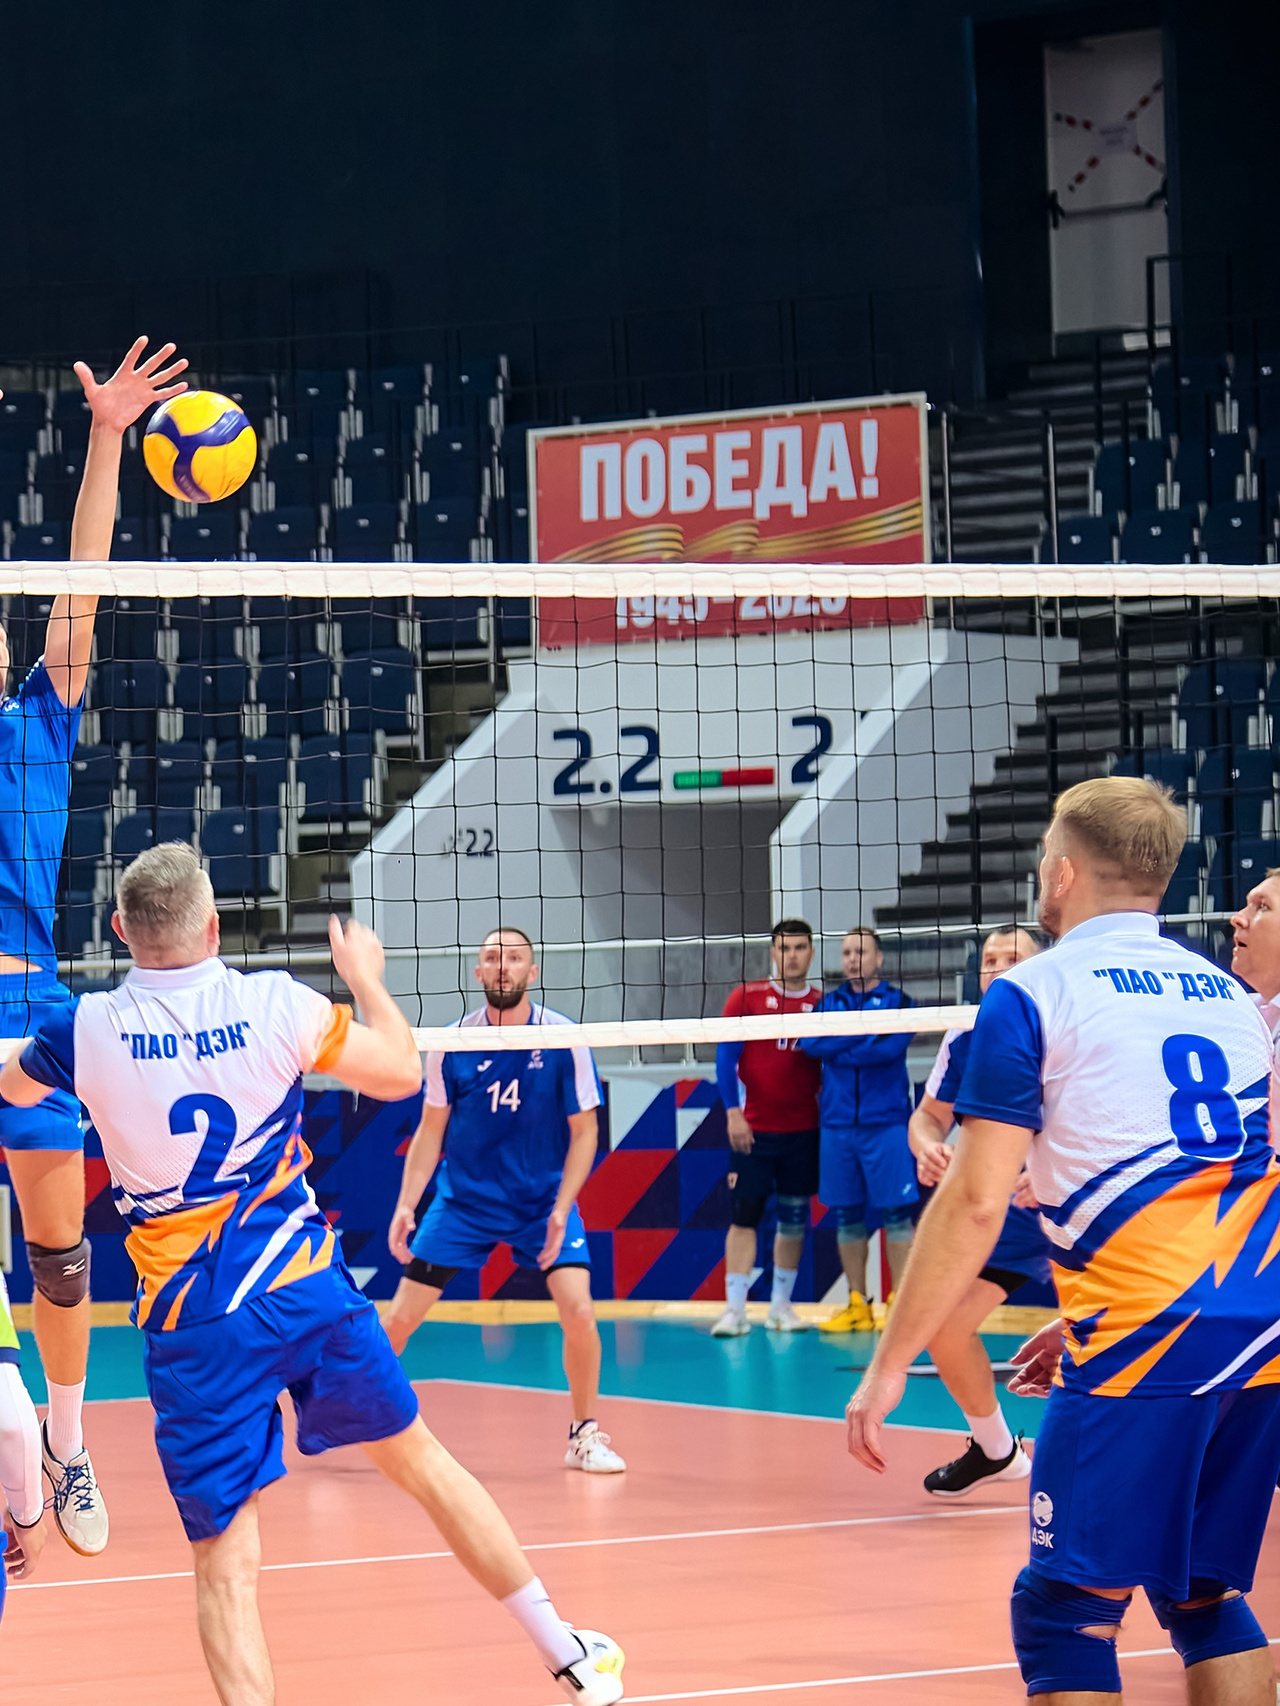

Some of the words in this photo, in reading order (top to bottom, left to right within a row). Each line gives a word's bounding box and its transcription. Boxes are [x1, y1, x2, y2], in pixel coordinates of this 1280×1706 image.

[580, 419, 878, 521] ПОБЕДА!
[553, 725, 662, 795] 2.2
[486, 1078, 522, 1114] 14
[1160, 1032, 1248, 1162] 8
[168, 1092, 250, 1204] 2
